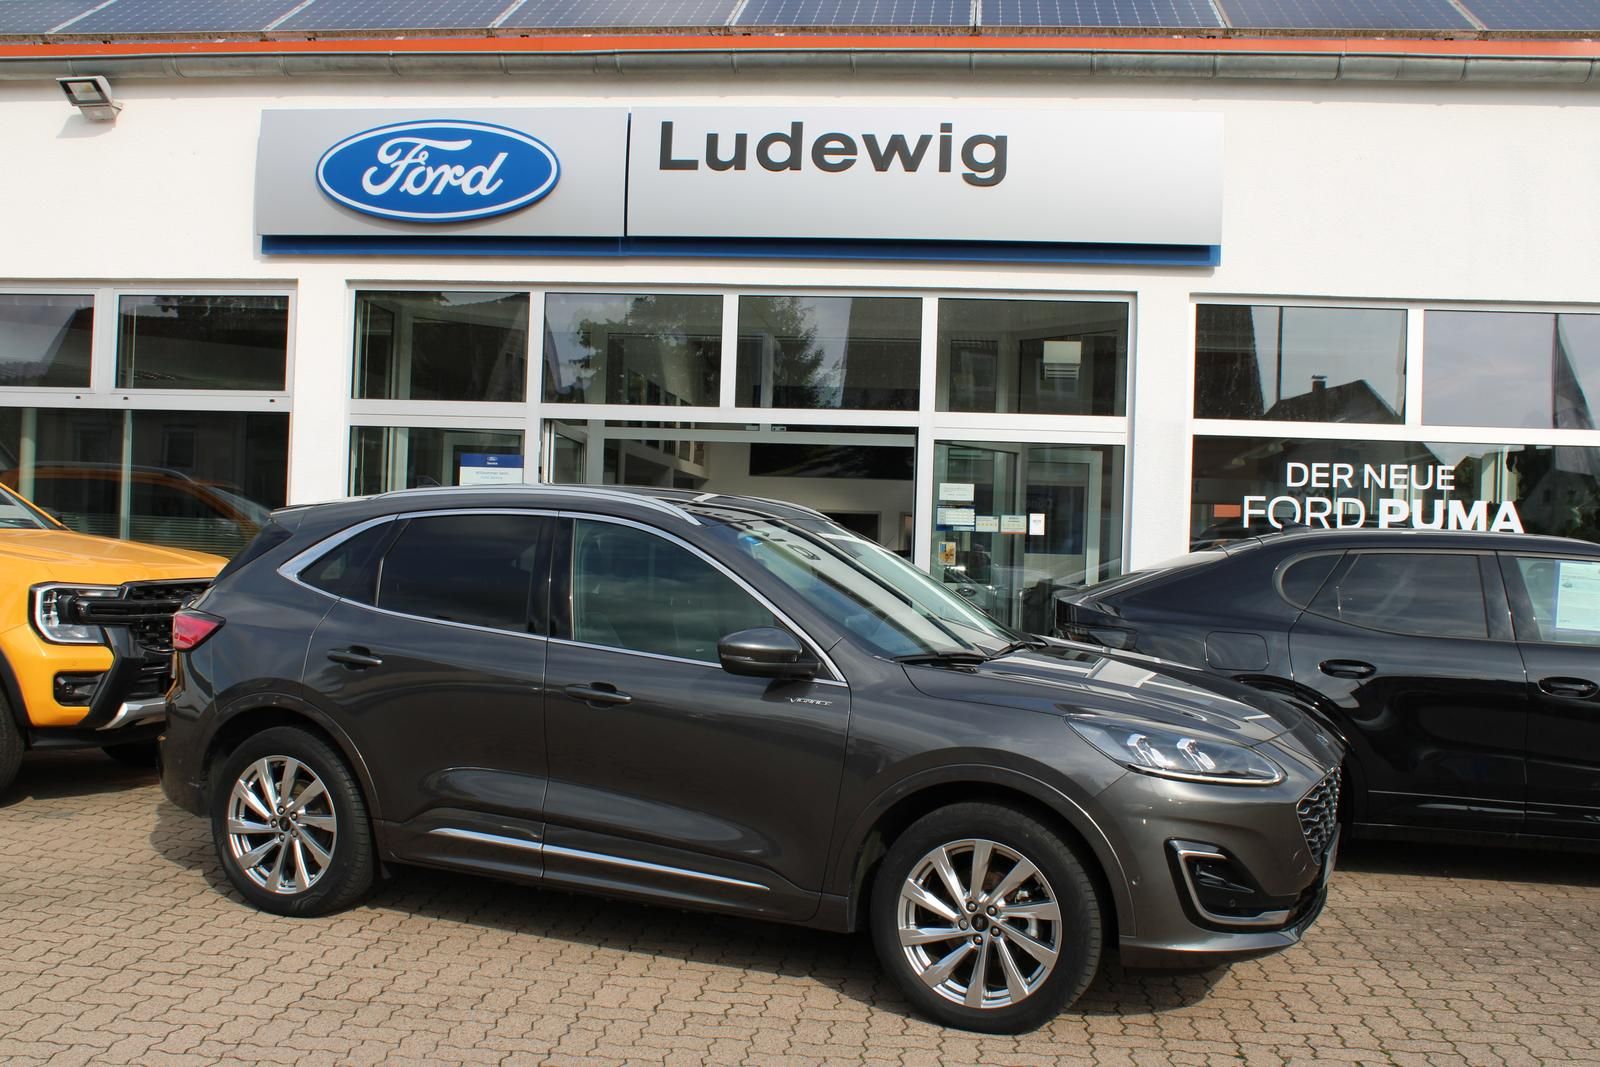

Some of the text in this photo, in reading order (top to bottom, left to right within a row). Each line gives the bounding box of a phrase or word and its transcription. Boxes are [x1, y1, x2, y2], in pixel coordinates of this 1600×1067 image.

[361, 136, 509, 197] Ford
[658, 120, 1009, 188] Ludewig
[1286, 461, 1456, 491] DER NEUE
[1242, 495, 1525, 534] FORD PUMA
